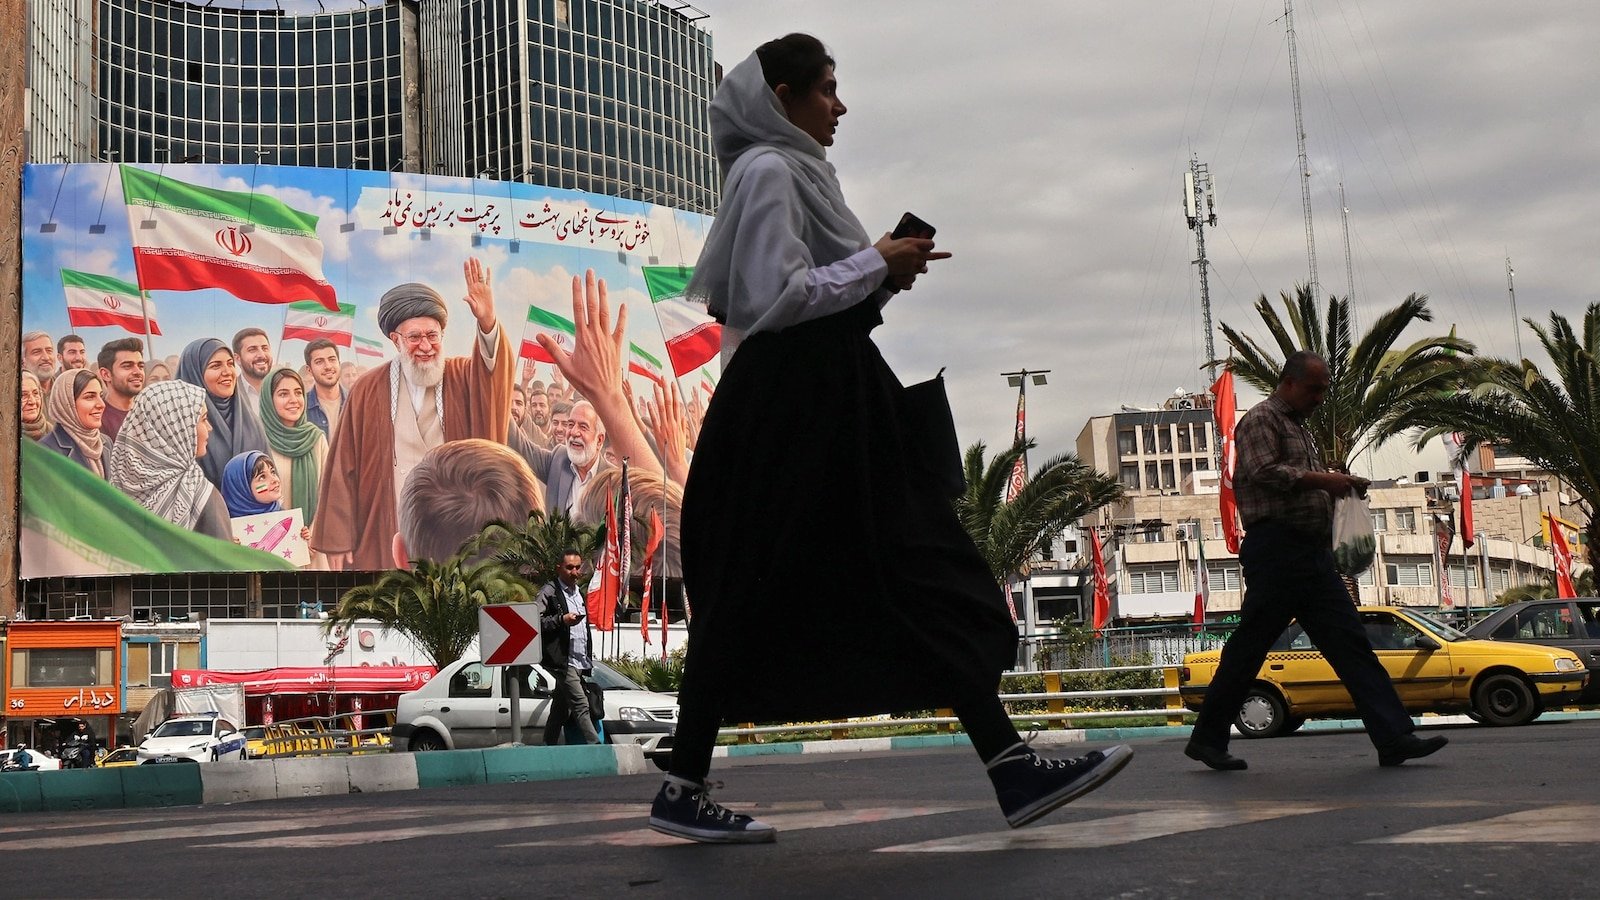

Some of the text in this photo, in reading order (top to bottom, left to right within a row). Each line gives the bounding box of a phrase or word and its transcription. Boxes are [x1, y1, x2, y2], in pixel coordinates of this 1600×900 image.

[412, 201, 442, 227] زمین
[443, 209, 455, 228] بر
[456, 204, 501, 235] پرچمت
[519, 203, 560, 231] بهشت
[625, 220, 650, 251] خوش
[11, 699, 25, 708] 36
[64, 688, 114, 709] دیدار
